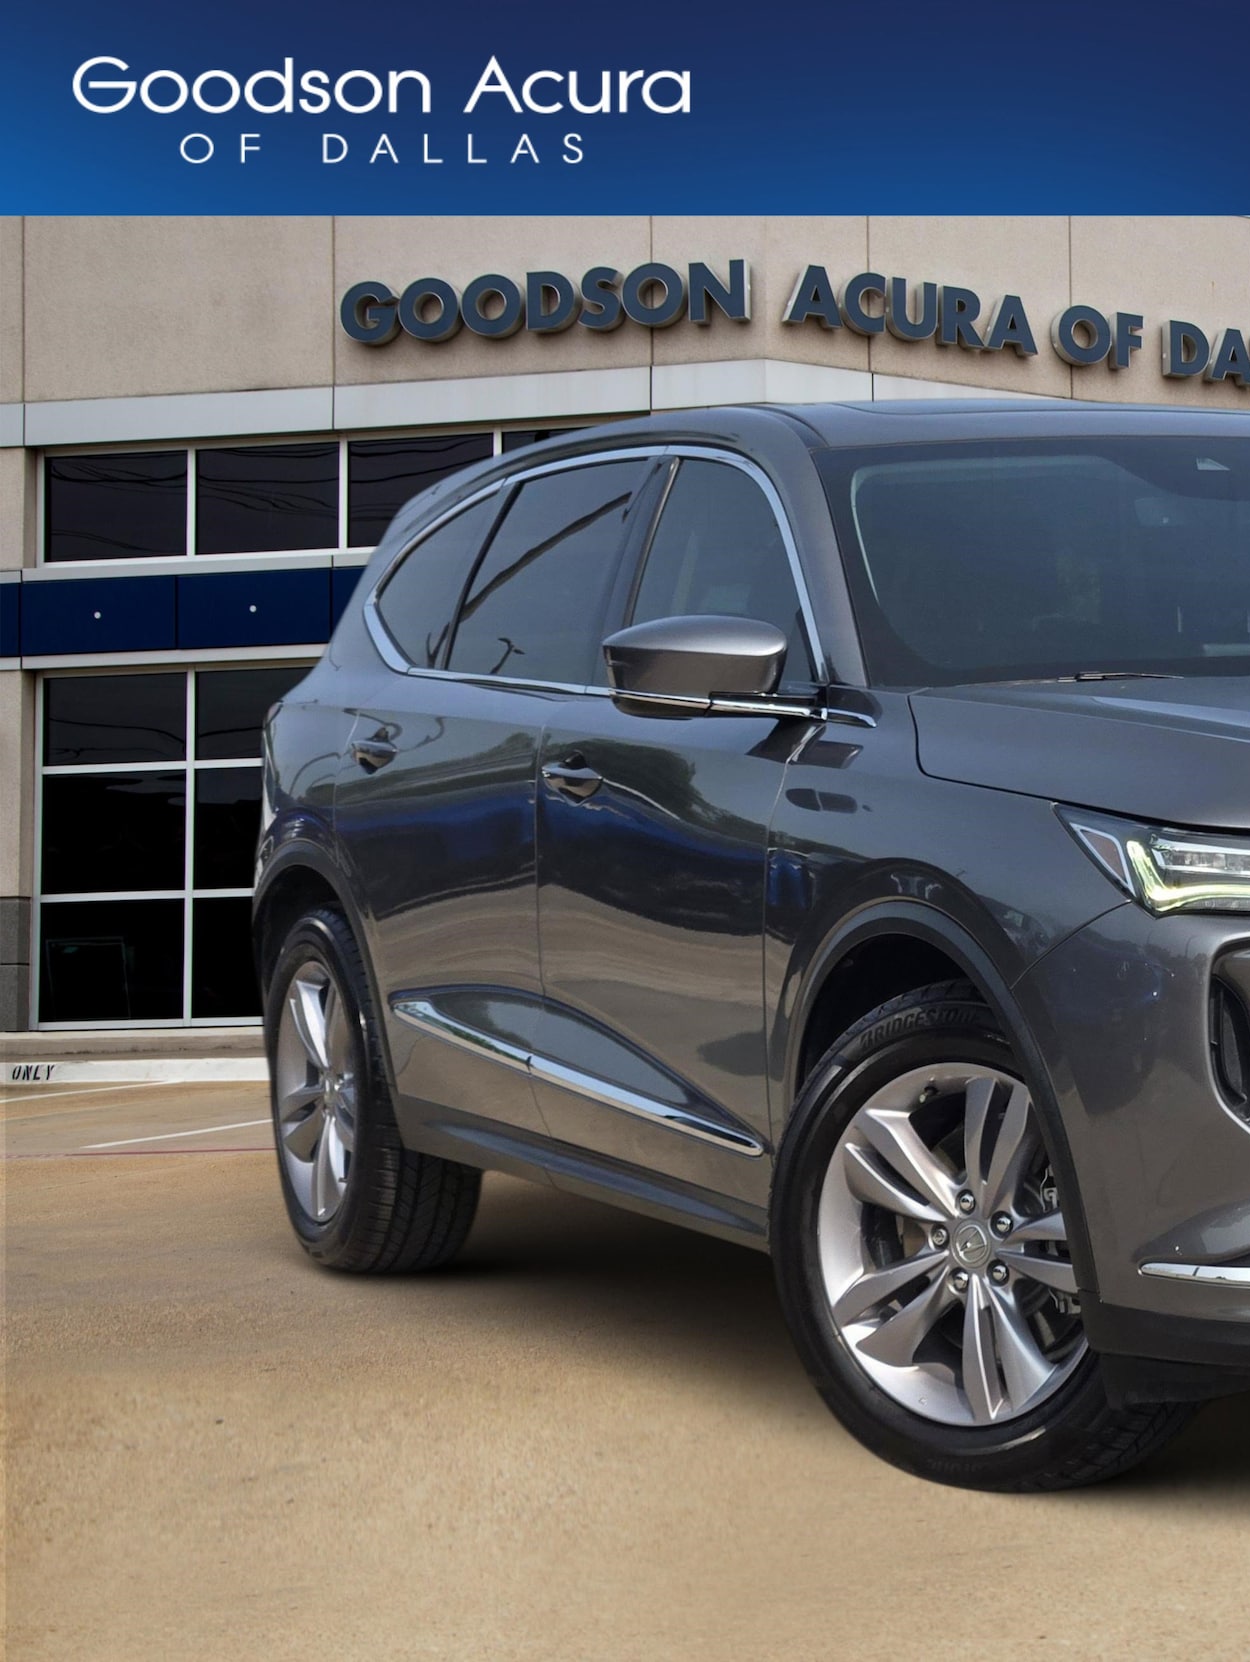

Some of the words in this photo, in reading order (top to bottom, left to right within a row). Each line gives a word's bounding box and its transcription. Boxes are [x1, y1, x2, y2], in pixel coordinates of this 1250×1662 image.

[340, 258, 752, 346] GOODSON
[783, 264, 1038, 357] ACURA
[1051, 305, 1143, 369] OF
[12, 1064, 55, 1081] ONLY
